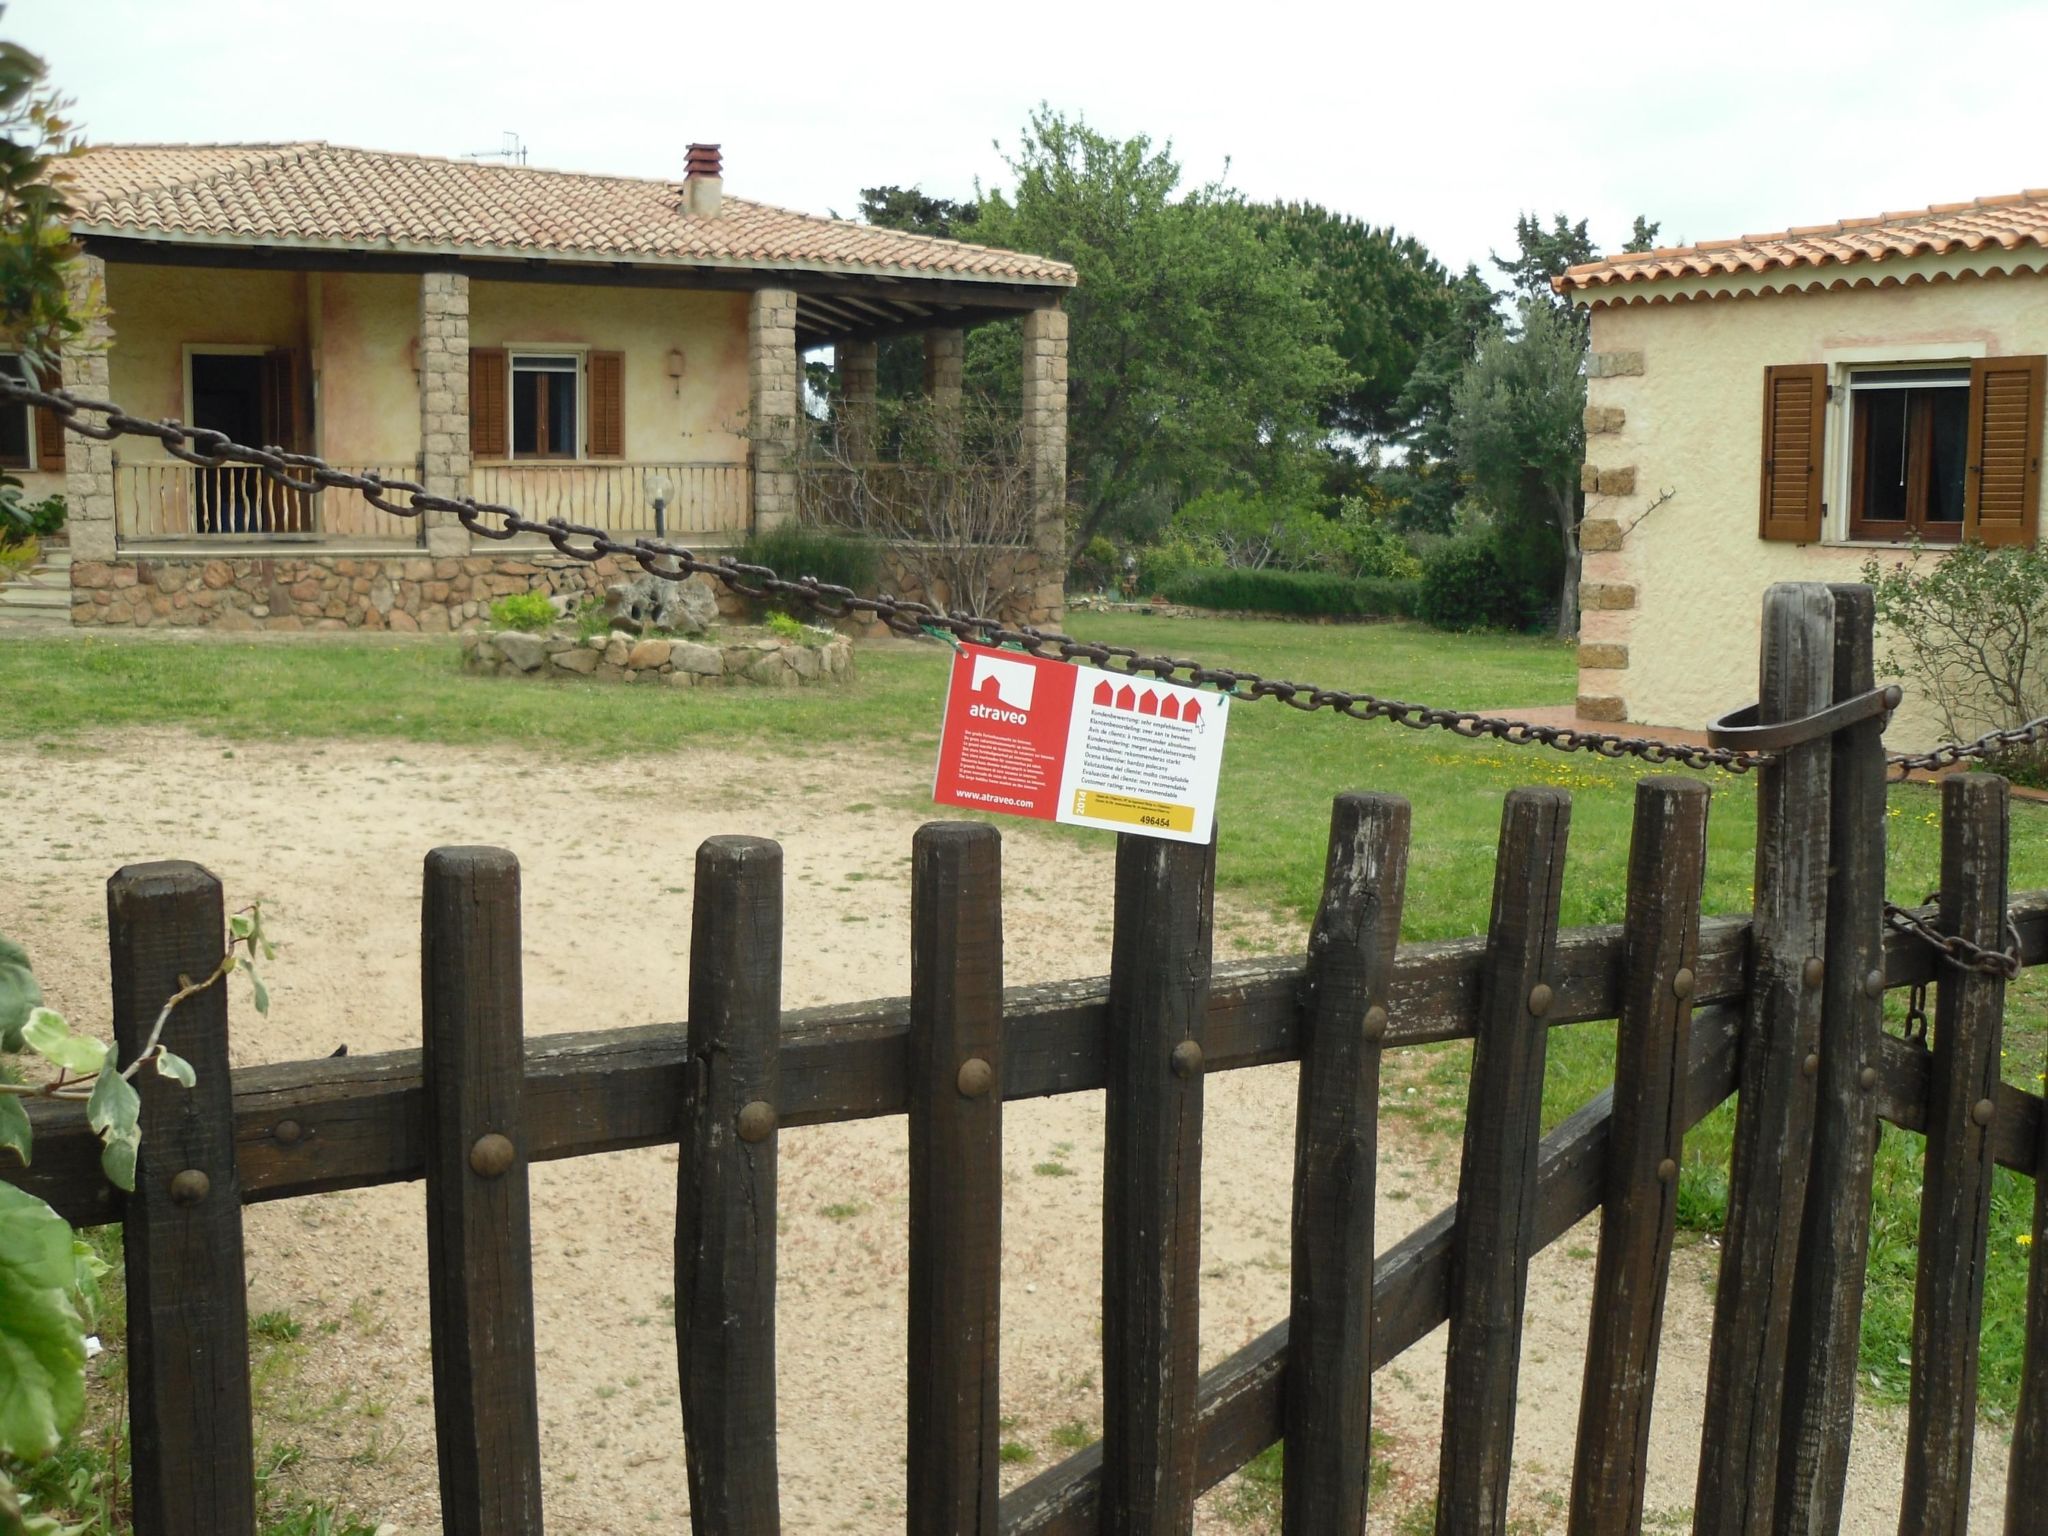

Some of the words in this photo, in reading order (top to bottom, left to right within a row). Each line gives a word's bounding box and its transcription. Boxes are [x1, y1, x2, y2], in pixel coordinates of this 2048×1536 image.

[970, 703, 1027, 725] atraveo
[1084, 751, 1101, 759] Ocena
[1080, 776, 1106, 786] Customer
[1137, 786, 1178, 798] recommendable
[956, 790, 1033, 808] www.atraveo.com
[1076, 791, 1086, 814] 2014
[1140, 815, 1170, 827] 496454
